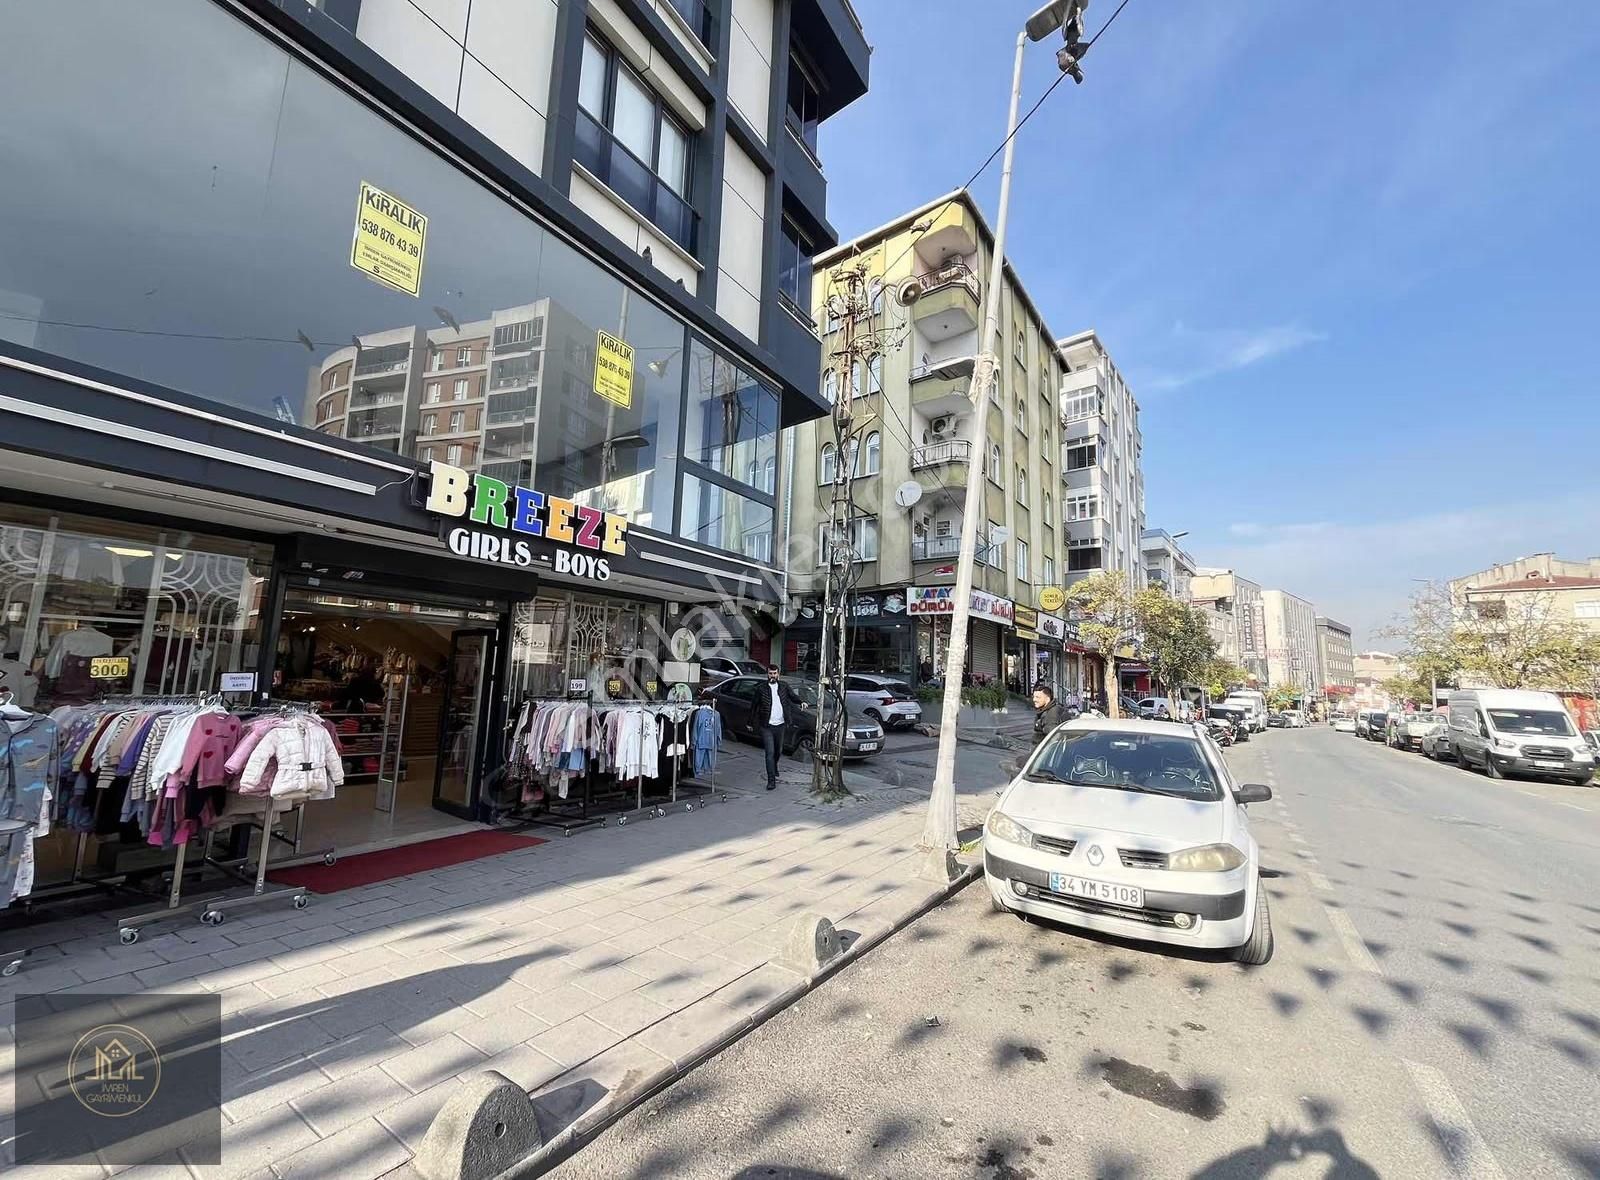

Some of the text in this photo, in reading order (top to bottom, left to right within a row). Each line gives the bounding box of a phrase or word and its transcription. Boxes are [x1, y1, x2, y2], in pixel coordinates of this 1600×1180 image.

[362, 218, 418, 258] 538 876 43 39
[426, 458, 628, 556] BREEZE
[449, 528, 531, 567] GIRLS
[555, 549, 610, 581] BOYS
[1243, 604, 1253, 650] KARDELEN
[1060, 877, 1138, 903] 34 YM 5108
